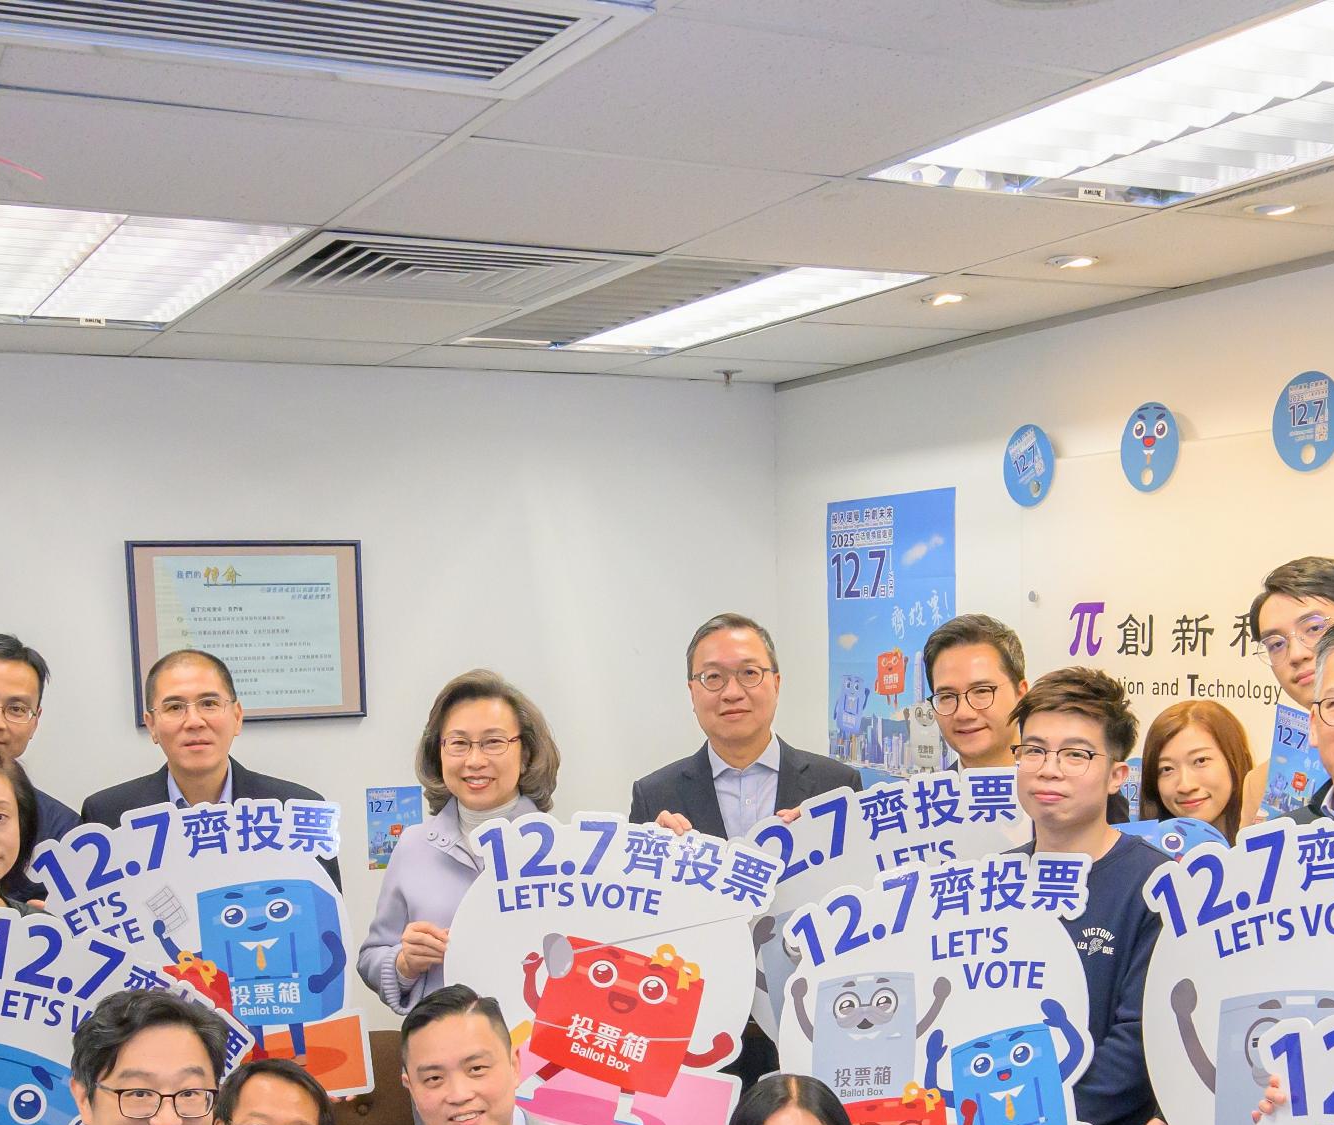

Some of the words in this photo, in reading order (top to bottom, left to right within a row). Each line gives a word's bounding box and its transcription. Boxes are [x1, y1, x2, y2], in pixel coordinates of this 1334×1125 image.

[1152, 677, 1179, 696] and
[1186, 674, 1283, 706] Technology
[754, 799, 849, 884] 2.7
[859, 772, 1017, 841] 齊投票
[32, 812, 171, 902] 12.7
[181, 805, 338, 859] 齊投票
[477, 821, 618, 883] 12.7
[624, 827, 778, 908] 齊投票
[496, 882, 574, 913] LET'S
[582, 883, 663, 916] VOTE
[1151, 829, 1285, 939] 12.7
[63, 892, 128, 937] ET'S
[791, 870, 919, 967] 12.7
[929, 859, 1084, 919] 齊投票
[108, 918, 145, 945] TE
[930, 926, 1009, 961] LET'S
[1082, 928, 1115, 942] VICTORY
[1214, 908, 1295, 959] LET'S
[961, 961, 1046, 991] VOTE
[230, 982, 301, 1007] 投票箱
[239, 1005, 271, 1018] Ballot
[273, 1003, 294, 1016] Box
[566, 1013, 650, 1063] 投票箱
[570, 1042, 605, 1063] Ballot
[606, 1055, 631, 1072] Box
[834, 1066, 891, 1088] 投票箱
[840, 1088, 865, 1098] Ballot
[867, 1087, 884, 1096] Box
